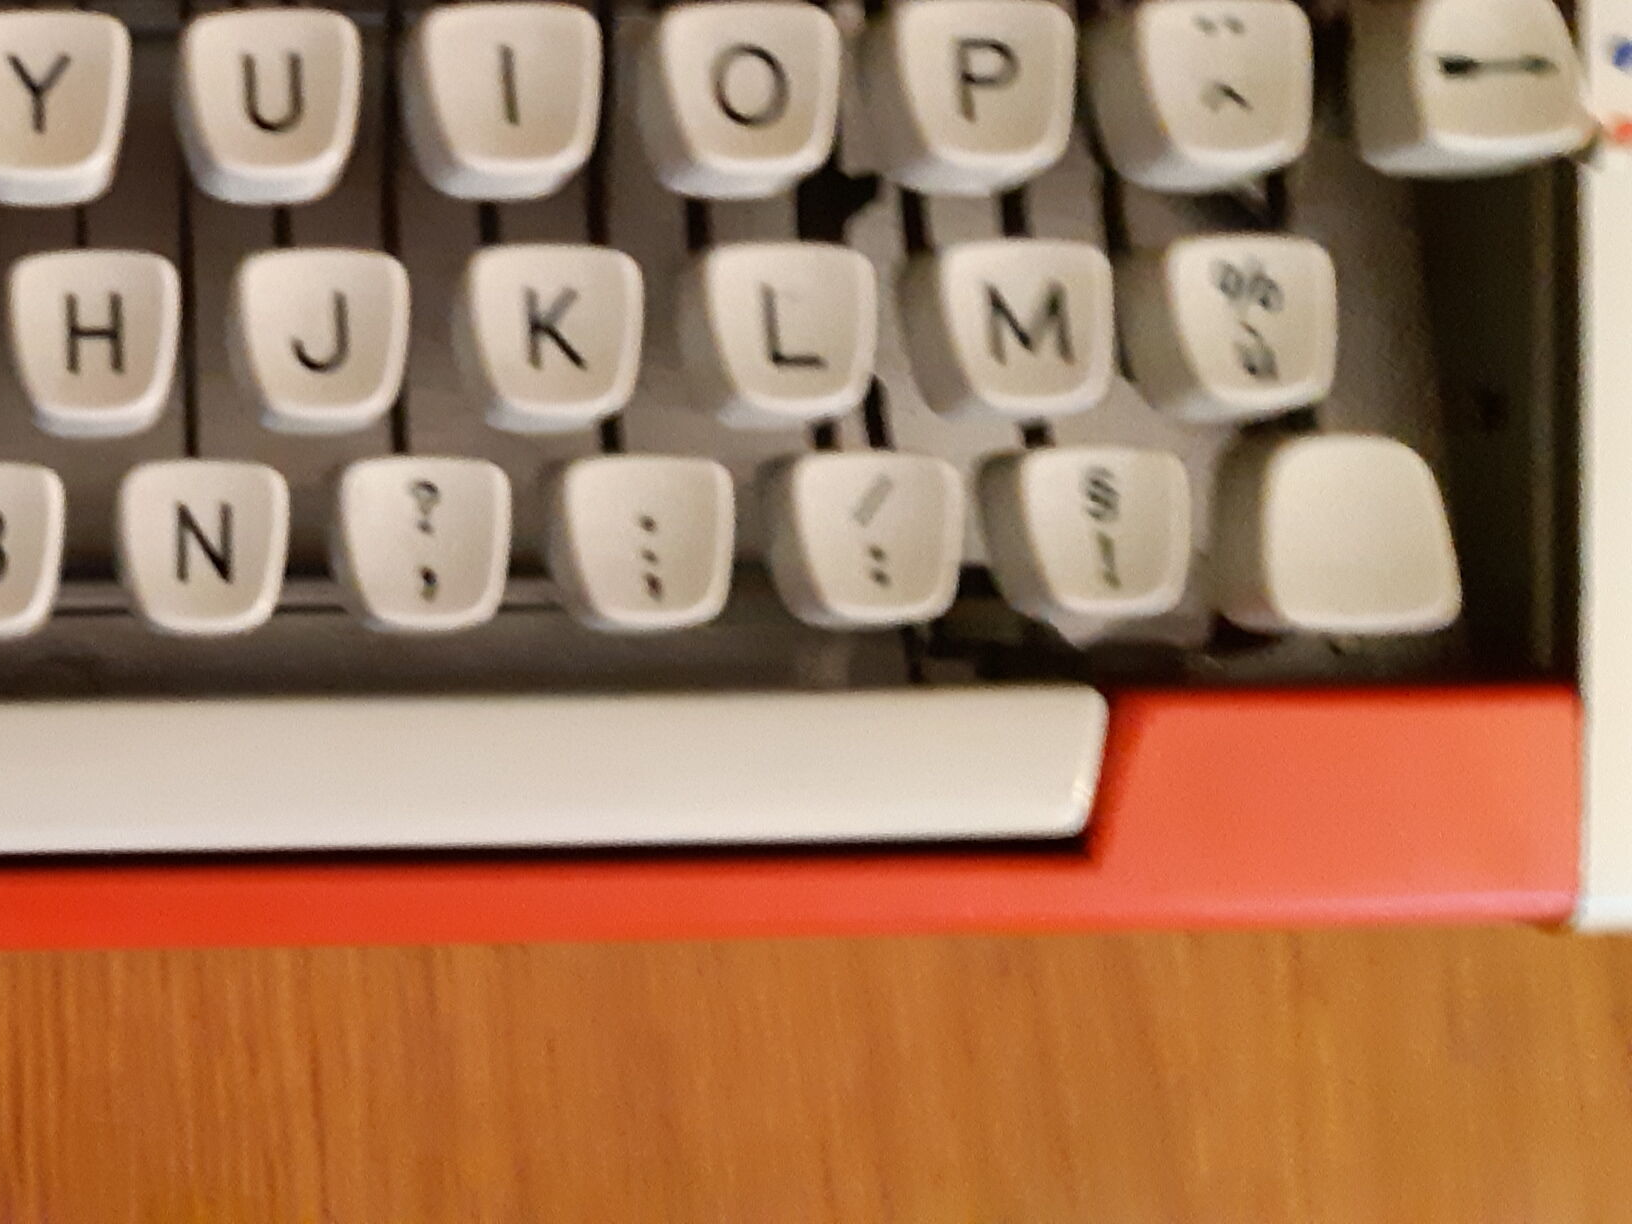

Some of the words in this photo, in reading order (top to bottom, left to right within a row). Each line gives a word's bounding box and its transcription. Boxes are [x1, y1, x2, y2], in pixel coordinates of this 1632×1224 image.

[9, 55, 70, 134] Y
[243, 54, 305, 135] U
[500, 46, 521, 127] I
[714, 44, 788, 128] O
[958, 39, 1018, 120] P
[66, 293, 125, 374] H
[292, 294, 349, 374] J
[523, 286, 589, 372] K
[764, 284, 826, 372] L
[987, 285, 1075, 364] M
[177, 504, 234, 584] N
